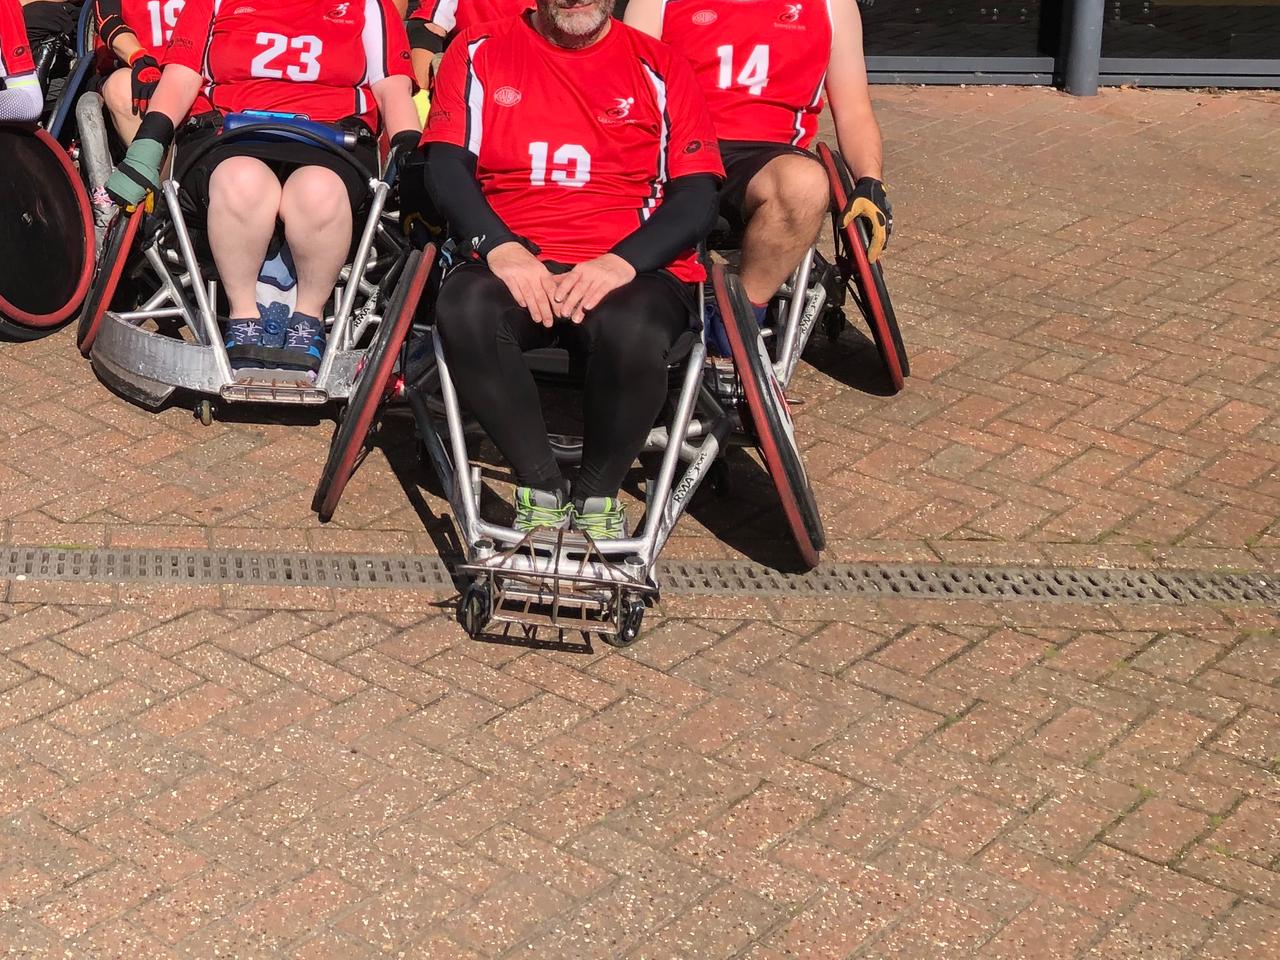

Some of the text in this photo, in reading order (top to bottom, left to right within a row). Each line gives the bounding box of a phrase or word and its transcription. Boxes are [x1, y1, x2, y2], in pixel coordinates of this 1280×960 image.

[251, 31, 323, 82] 23
[716, 44, 770, 96] 14
[528, 141, 592, 188] 13
[673, 477, 695, 503] RMA
